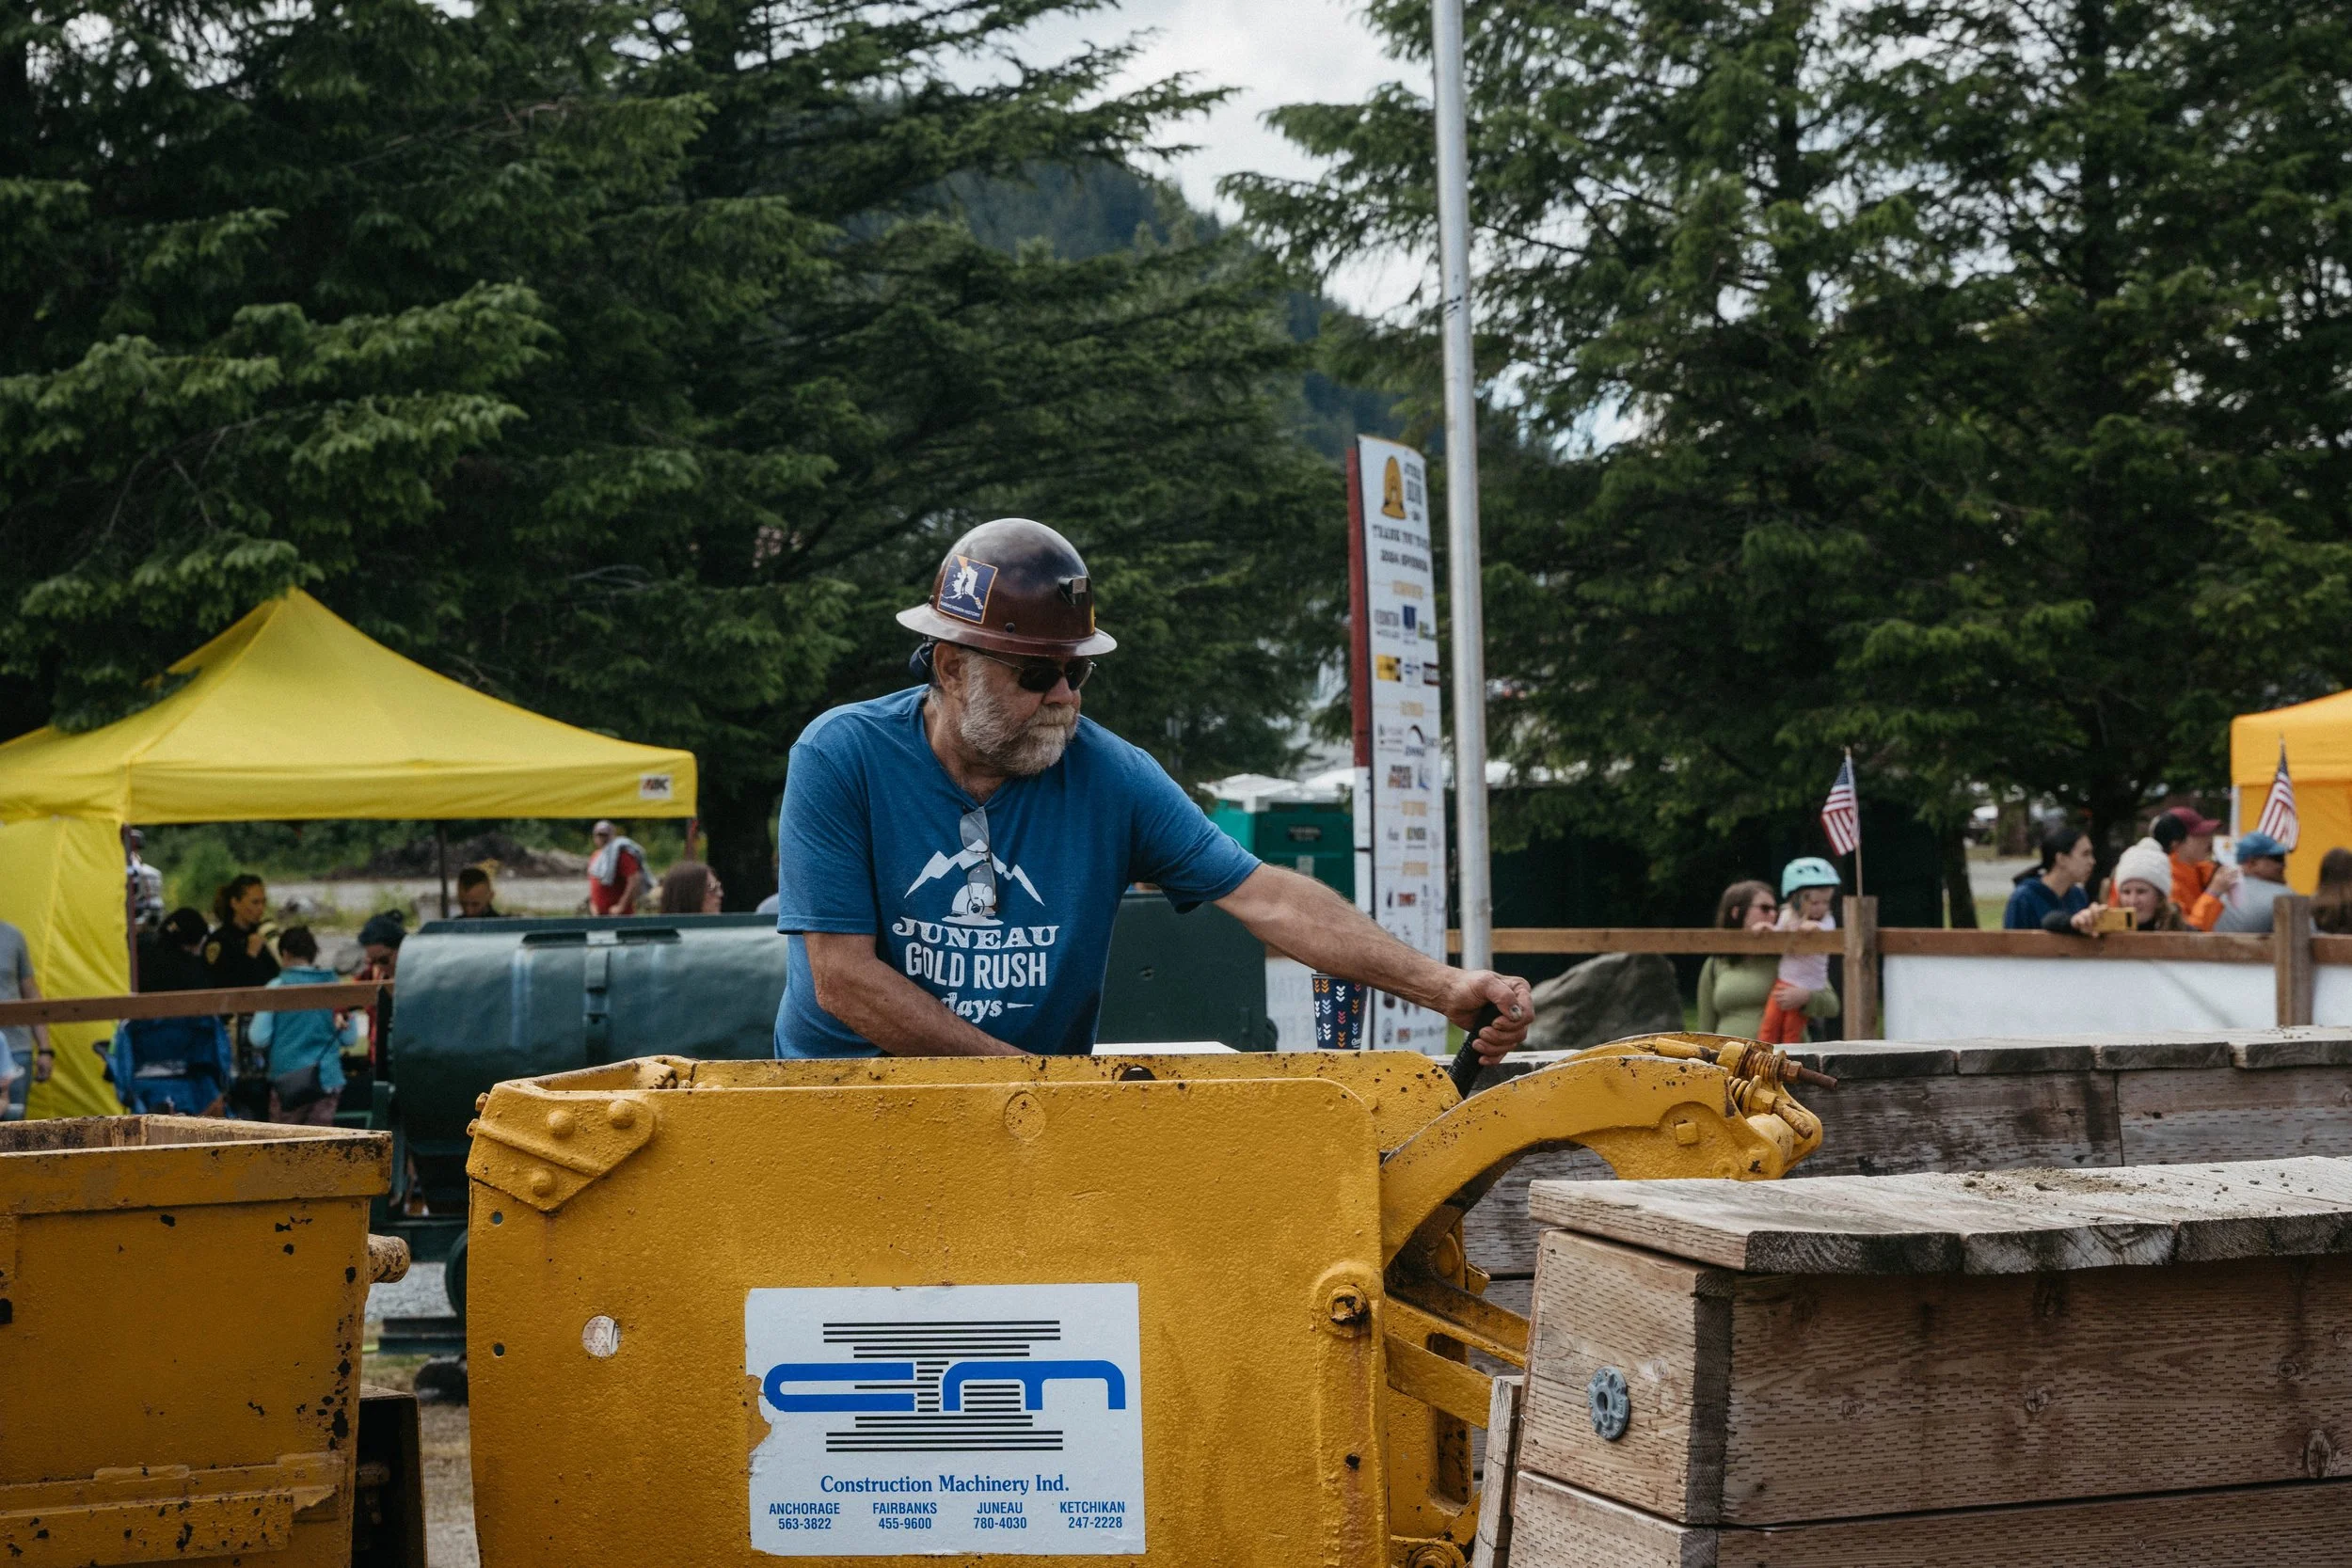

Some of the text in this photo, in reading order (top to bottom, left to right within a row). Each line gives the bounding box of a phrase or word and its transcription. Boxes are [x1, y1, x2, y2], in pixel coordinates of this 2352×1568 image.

[892, 916, 1060, 950] JUNEAU
[905, 942, 1047, 990] GOLD RUSH
[819, 1473, 1071, 1497] Construction Machinery Ind.
[769, 1499, 1126, 1516] ANCHORAGE FAIRBANKS JUNEAU KETCHIKAN
[777, 1515, 1123, 1530] 563-3822 455-9600 780-4030 247-2228
